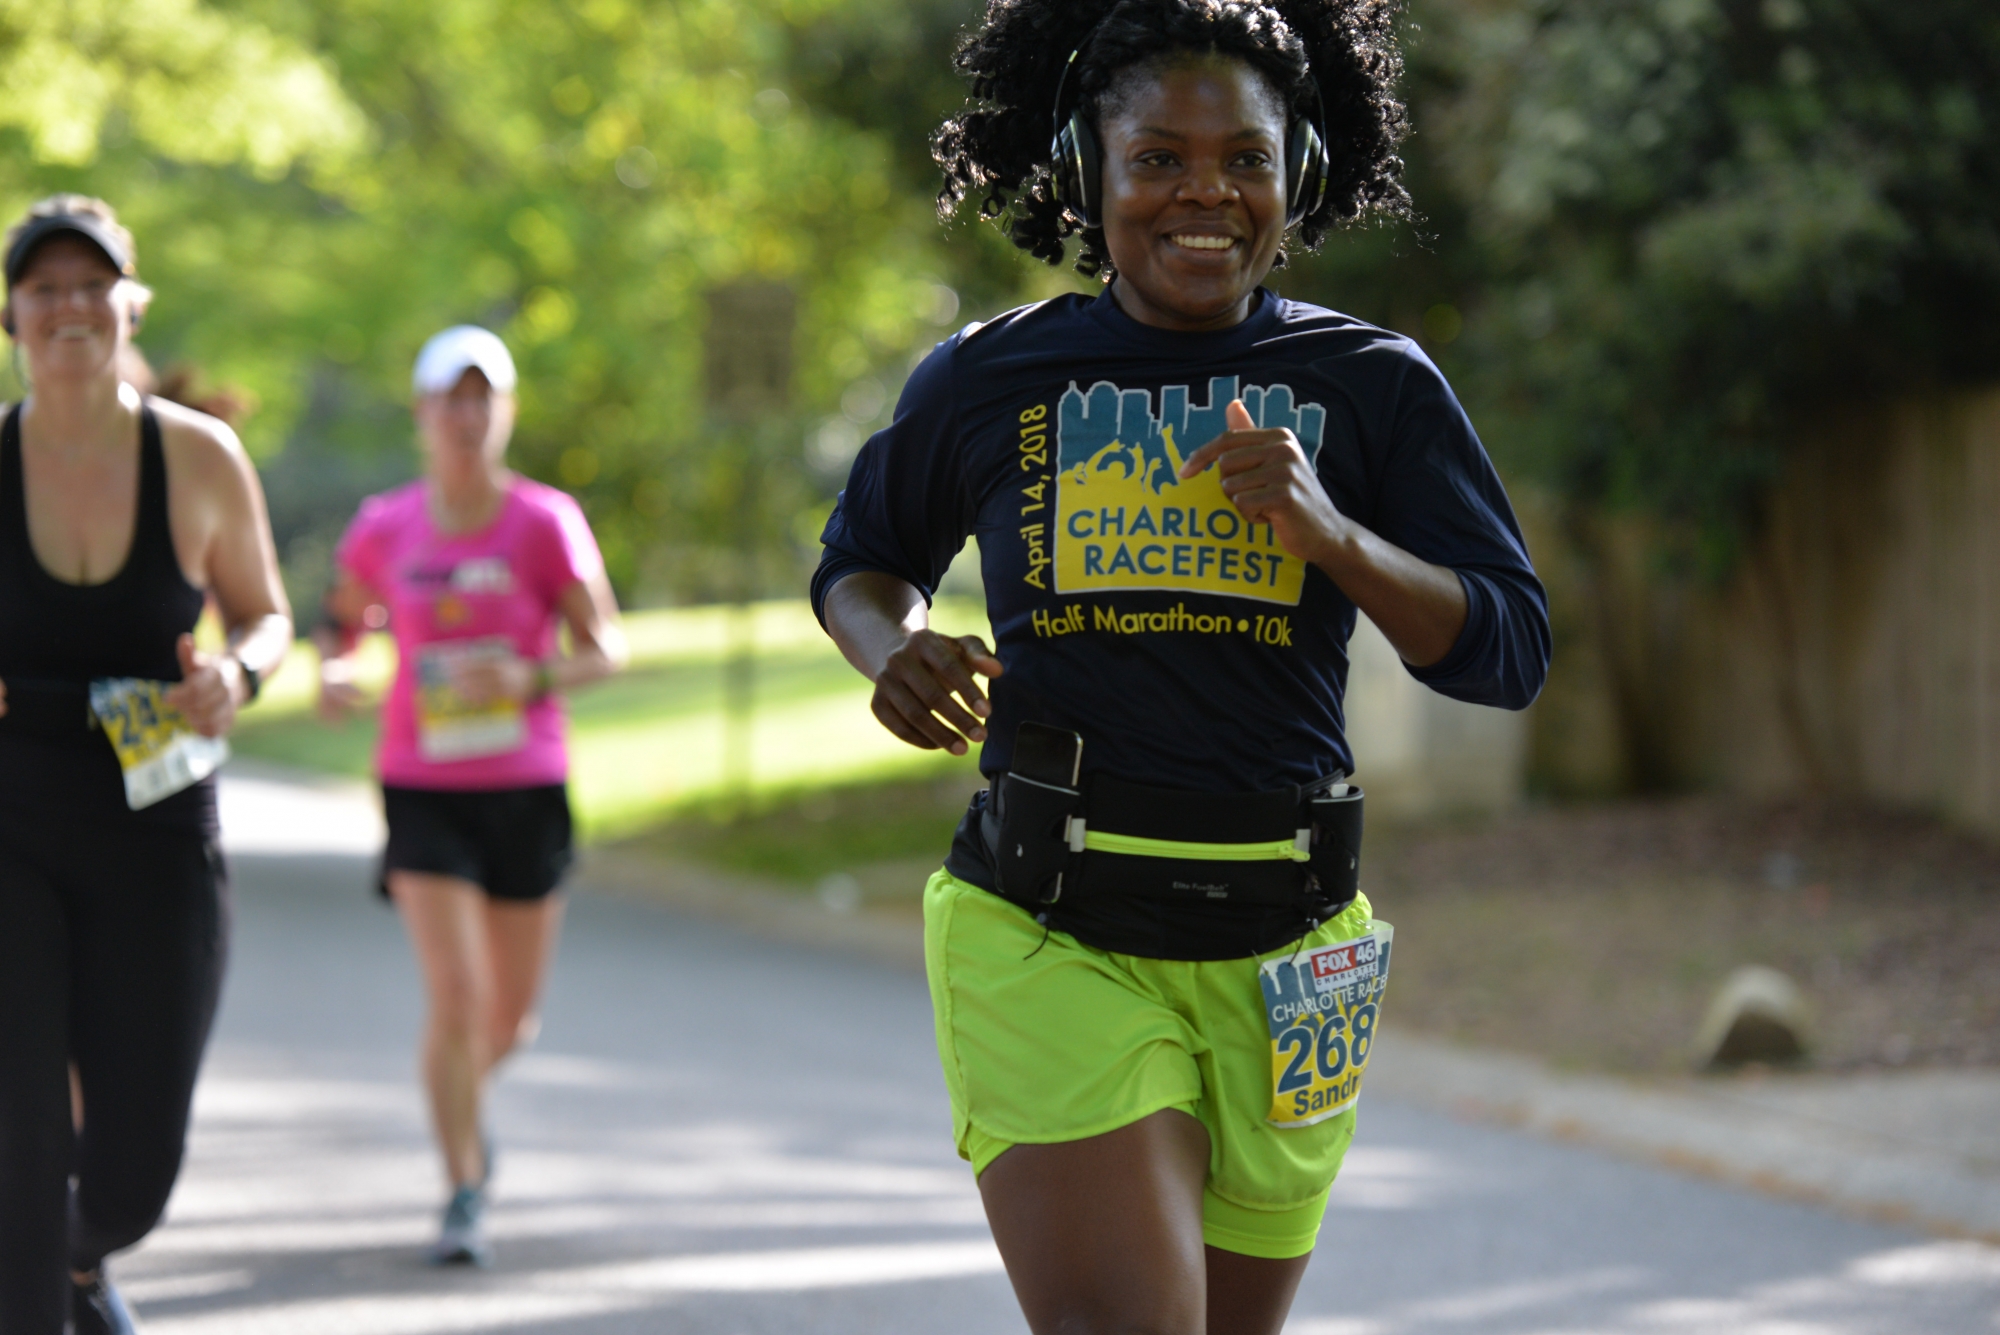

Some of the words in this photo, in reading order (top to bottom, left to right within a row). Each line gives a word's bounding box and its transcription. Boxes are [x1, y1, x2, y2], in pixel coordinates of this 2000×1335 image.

[1019, 404, 1048, 471] 2018
[1020, 475, 1051, 516] 14,
[1066, 504, 1275, 547] CHARLO
[1020, 523, 1051, 590] April
[1084, 541, 1283, 587] RACEFEST
[1032, 604, 1086, 638] Half
[1093, 602, 1232, 634] Marathon
[1254, 614, 1293, 647] 10k
[1316, 949, 1353, 975] FOX
[1355, 941, 1376, 963] 46
[1316, 963, 1377, 986] CHARLOTTE
[1356, 970, 1377, 982] WJZY
[1272, 989, 1355, 1022] CHARLOTTE
[1357, 972, 1388, 999] RACE
[1293, 1067, 1363, 1117] Sandr
